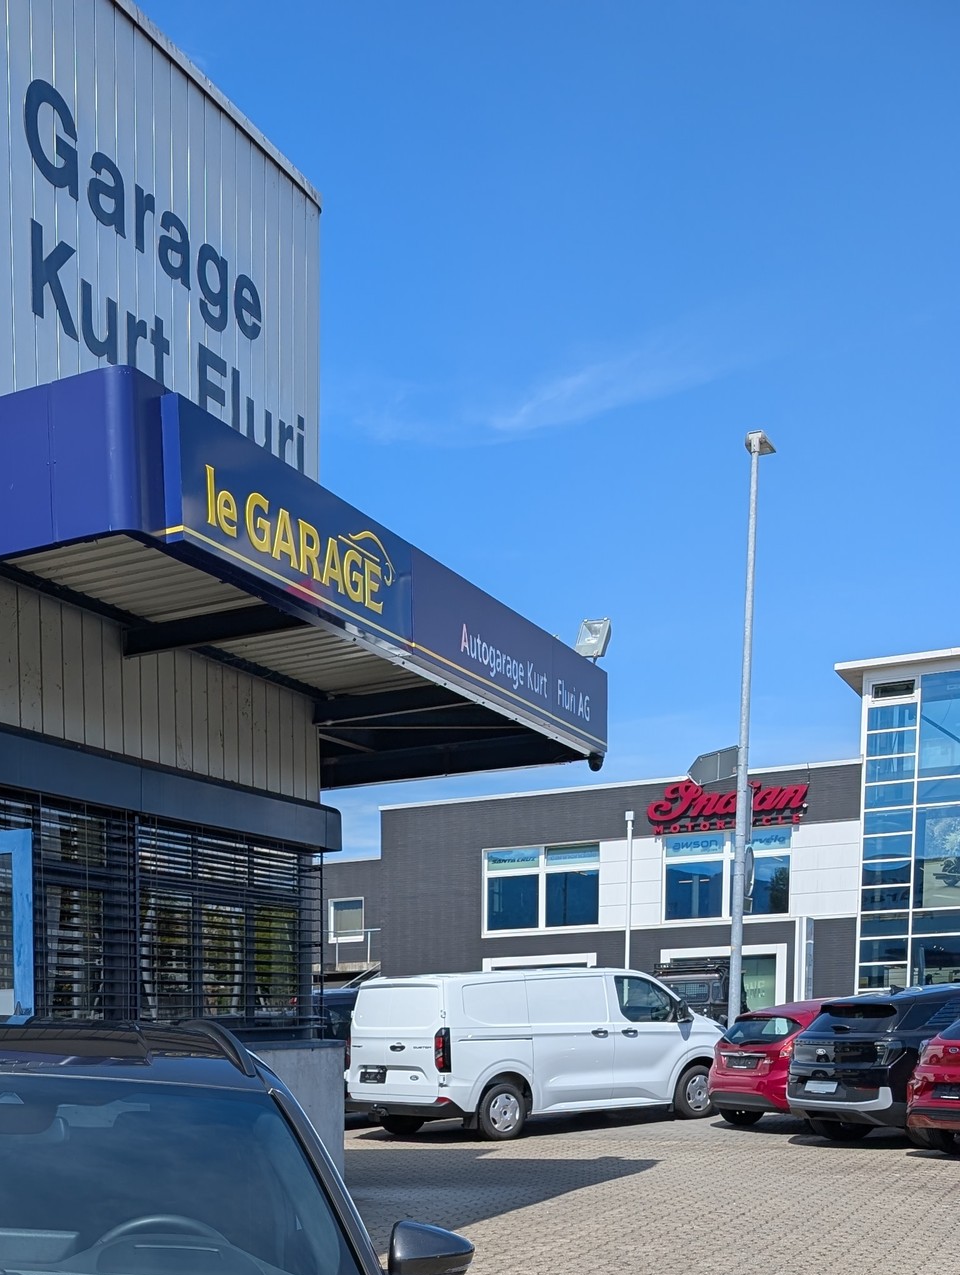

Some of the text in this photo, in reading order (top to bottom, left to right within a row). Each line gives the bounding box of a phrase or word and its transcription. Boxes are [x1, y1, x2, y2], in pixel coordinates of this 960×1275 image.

[24, 78, 262, 341] Garage
[30, 217, 305, 475] Kurt Fluri
[205, 463, 384, 615] le GARAGE
[460, 623, 590, 722] Autogarage Kurt Fluri AG
